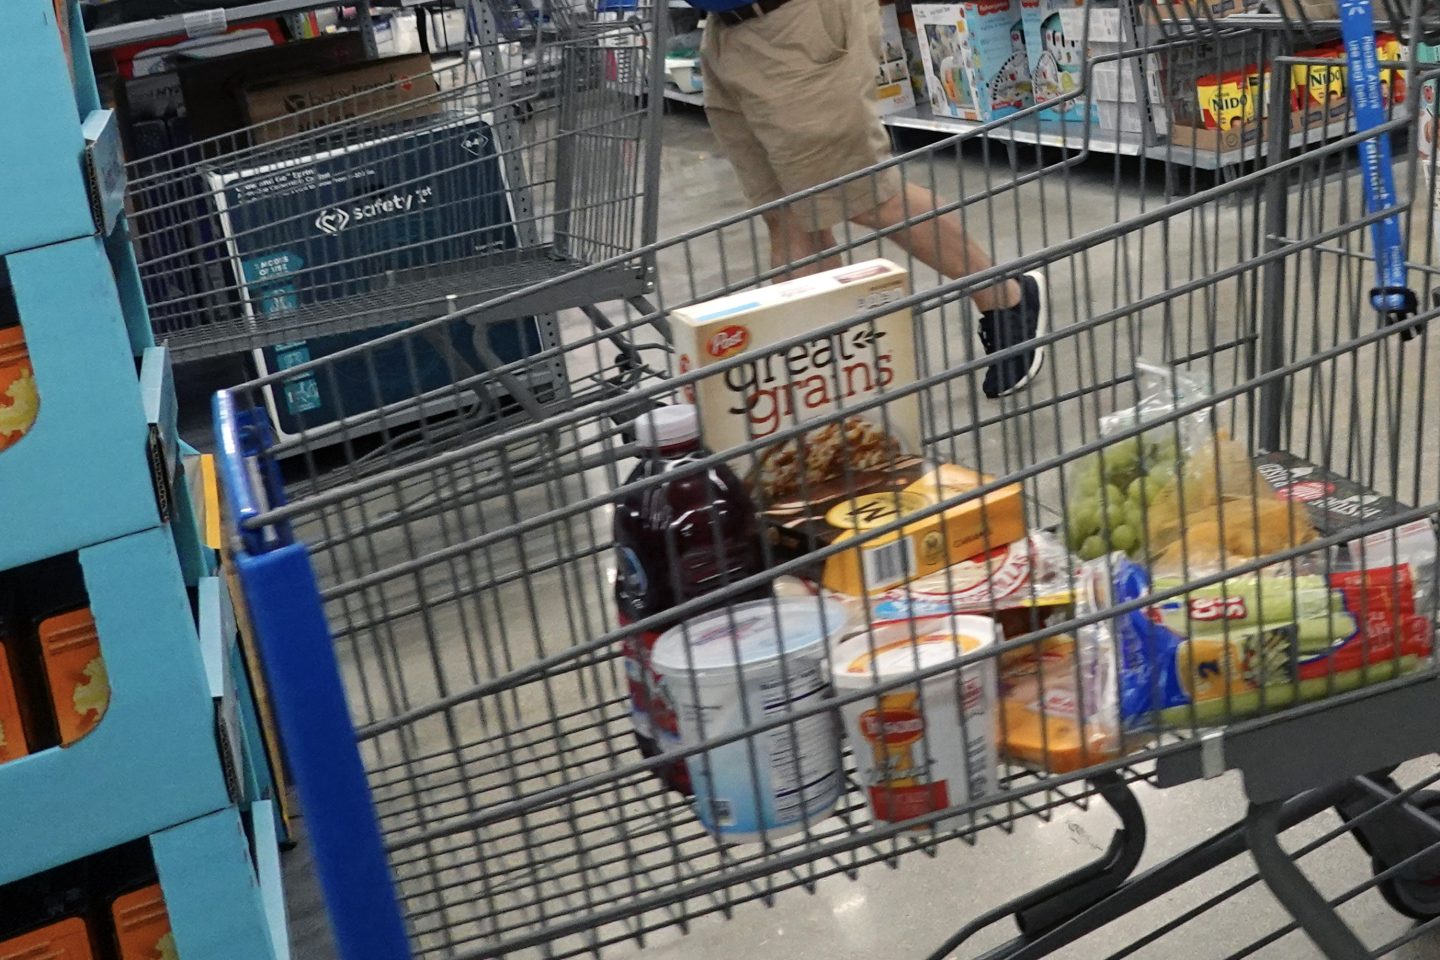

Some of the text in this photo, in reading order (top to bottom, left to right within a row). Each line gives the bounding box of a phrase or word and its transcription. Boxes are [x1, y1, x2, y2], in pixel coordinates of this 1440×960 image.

[1361, 36, 1379, 109] Please Always
[1212, 94, 1247, 112] NIDO
[353, 191, 412, 221] safety
[711, 329, 744, 353] Post
[724, 329, 854, 415] great
